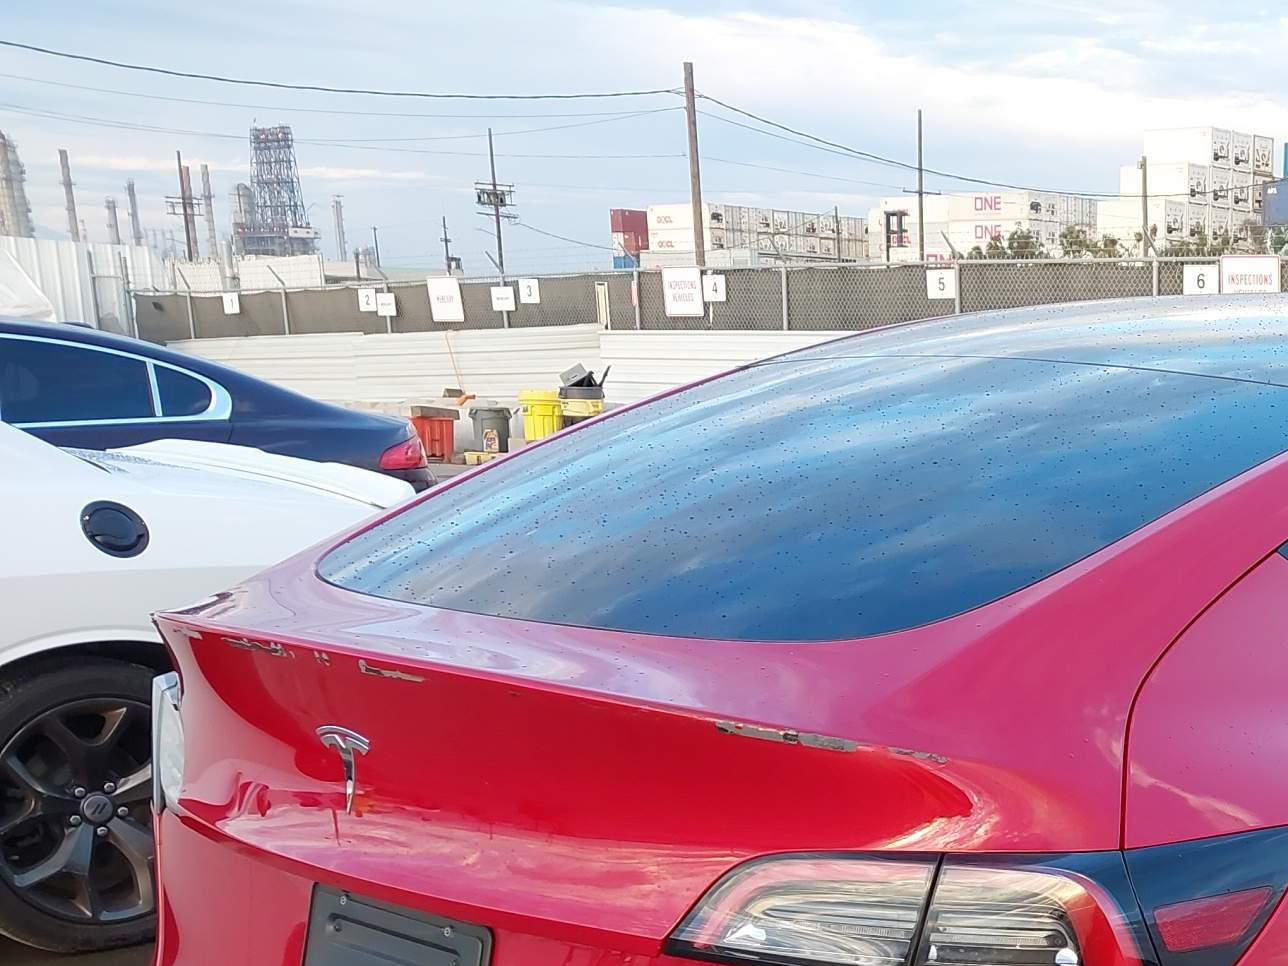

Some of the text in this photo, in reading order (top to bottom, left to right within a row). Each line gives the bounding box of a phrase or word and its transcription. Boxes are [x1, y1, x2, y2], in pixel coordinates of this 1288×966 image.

[975, 196, 1001, 211] ONE
[939, 277, 945, 291] 5
[1197, 273, 1205, 288] 6
[1228, 273, 1273, 286] INSPECTIONS
[527, 285, 533, 297] 3
[712, 281, 718, 294] 4
[365, 294, 371, 306] 2
